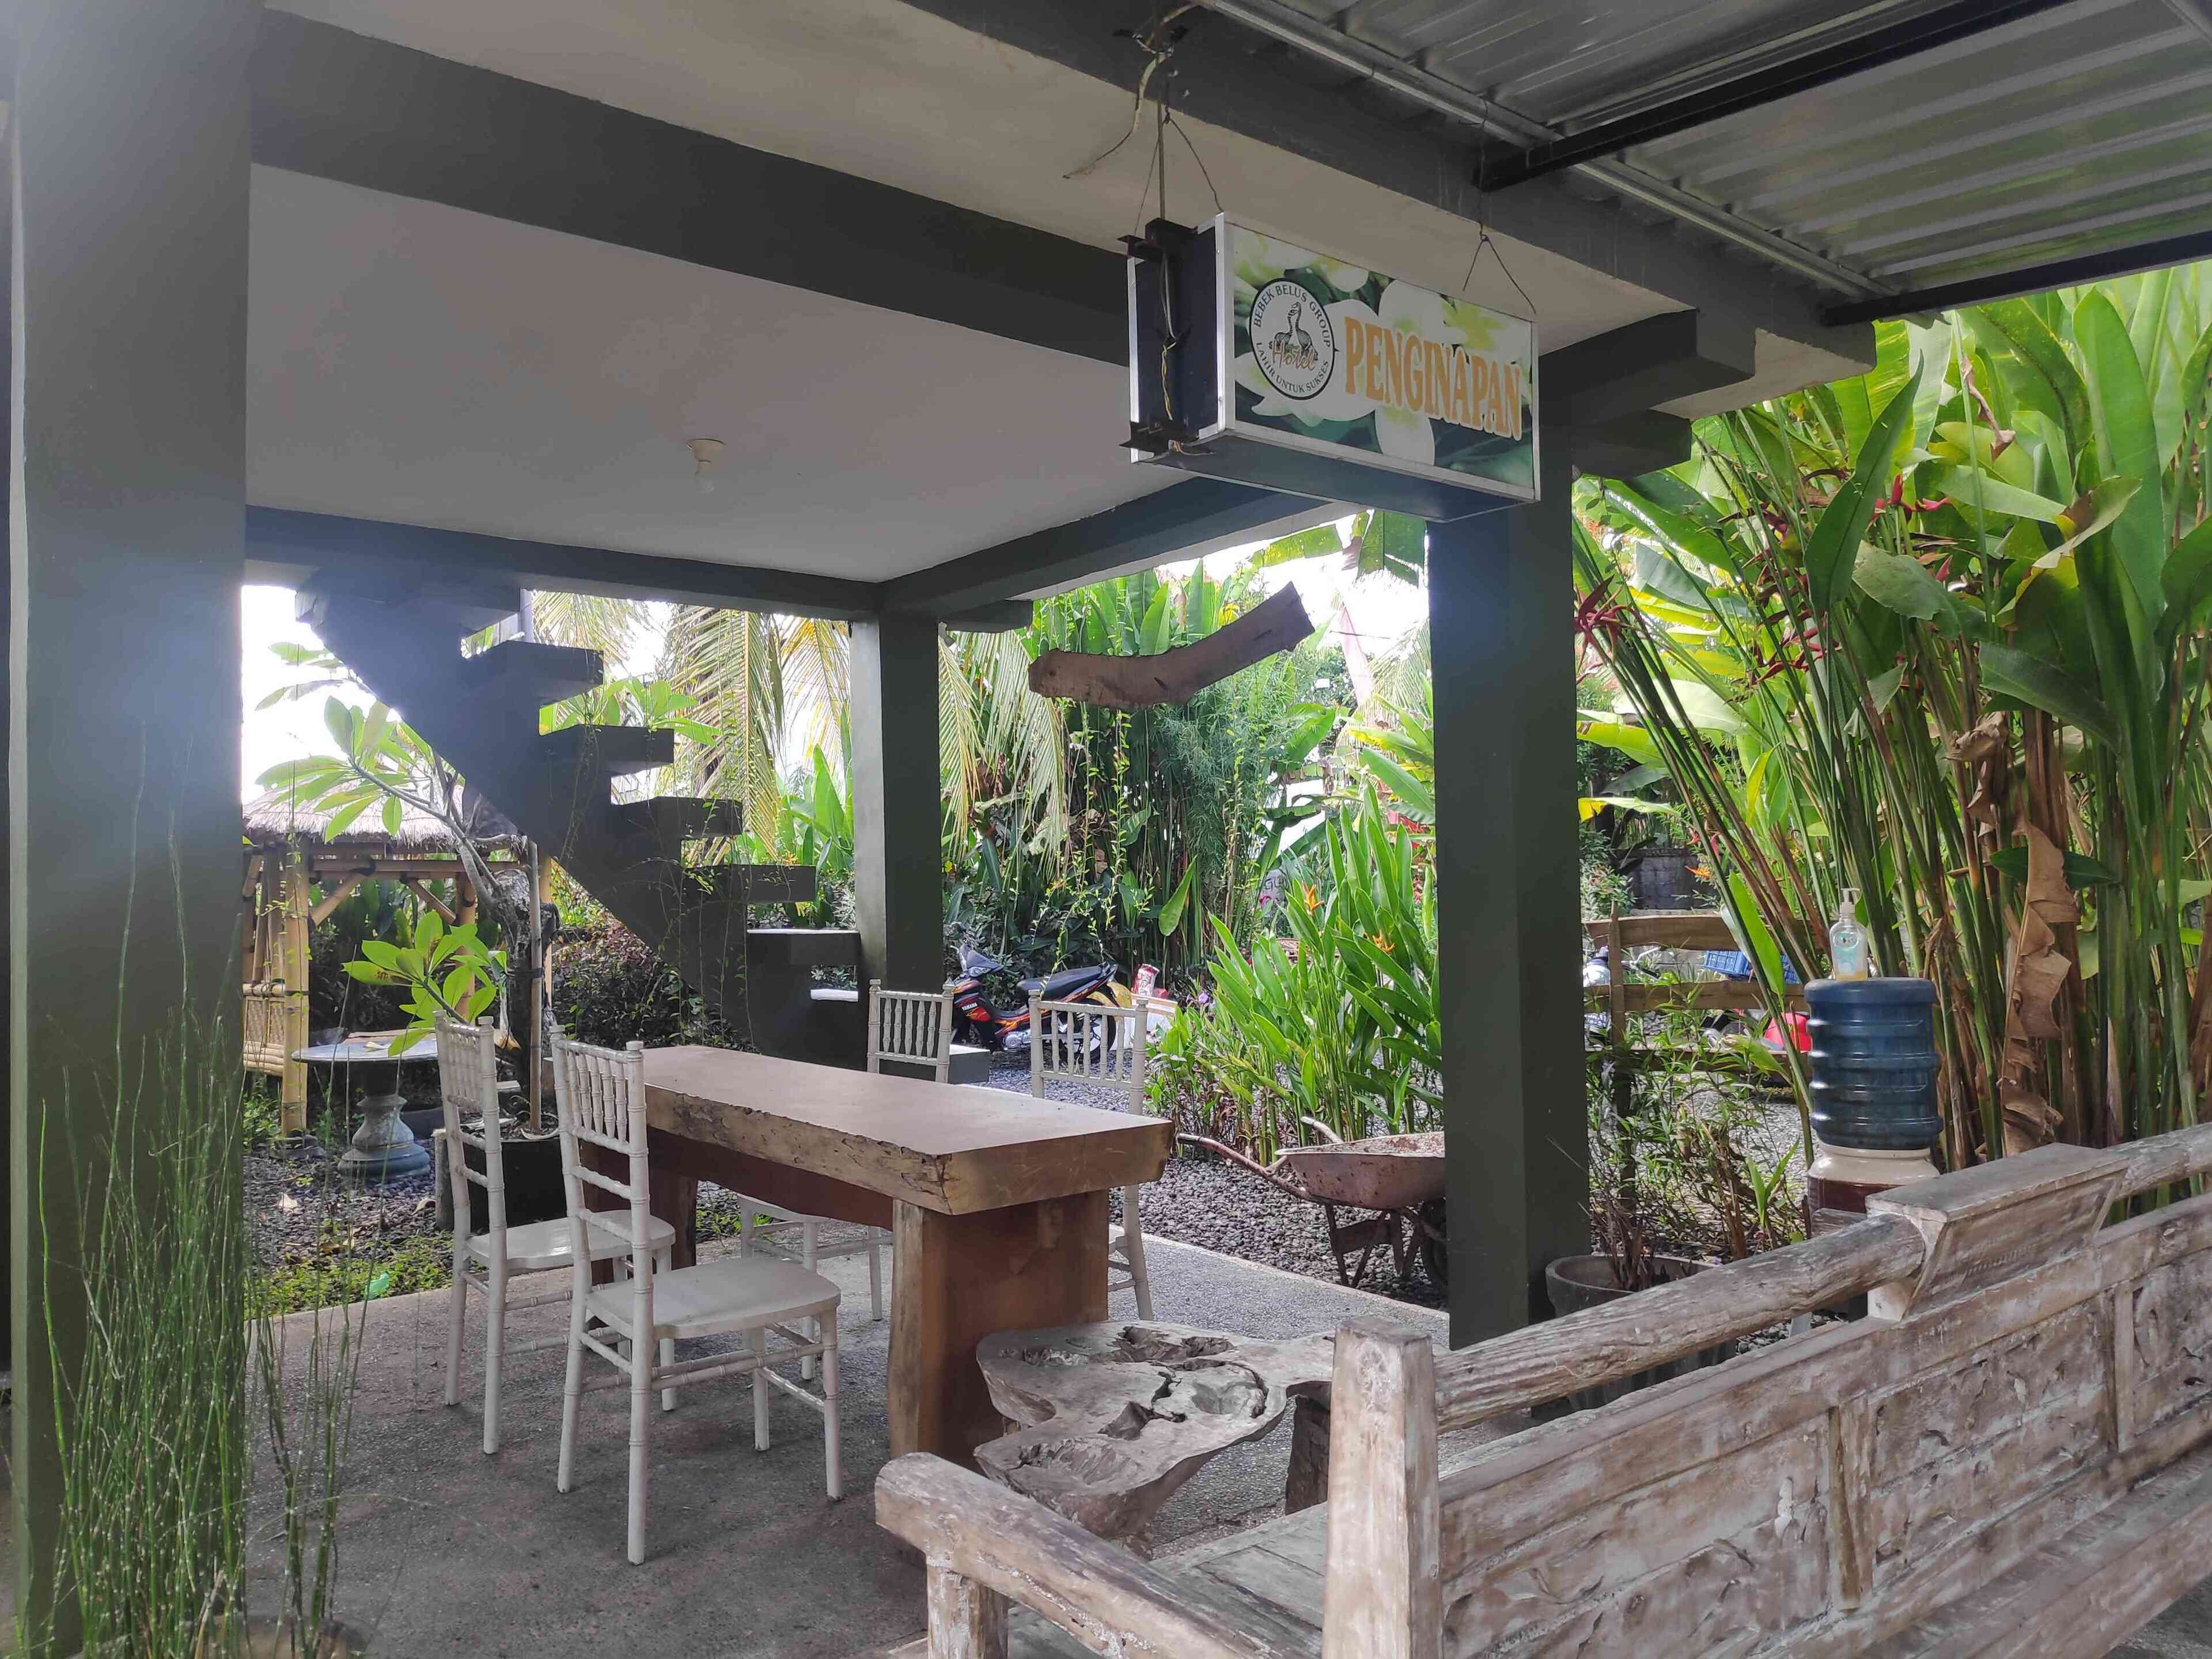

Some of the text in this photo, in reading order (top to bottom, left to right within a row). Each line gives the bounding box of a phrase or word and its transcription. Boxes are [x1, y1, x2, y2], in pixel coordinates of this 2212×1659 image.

[1253, 285, 1331, 348] BEBEK BELUS GROUP
[1256, 342, 1329, 393] LAHIR UNTUK SUKSES
[1271, 340, 1315, 372] Hotel
[1345, 316, 1521, 440] PENGINAPAN
